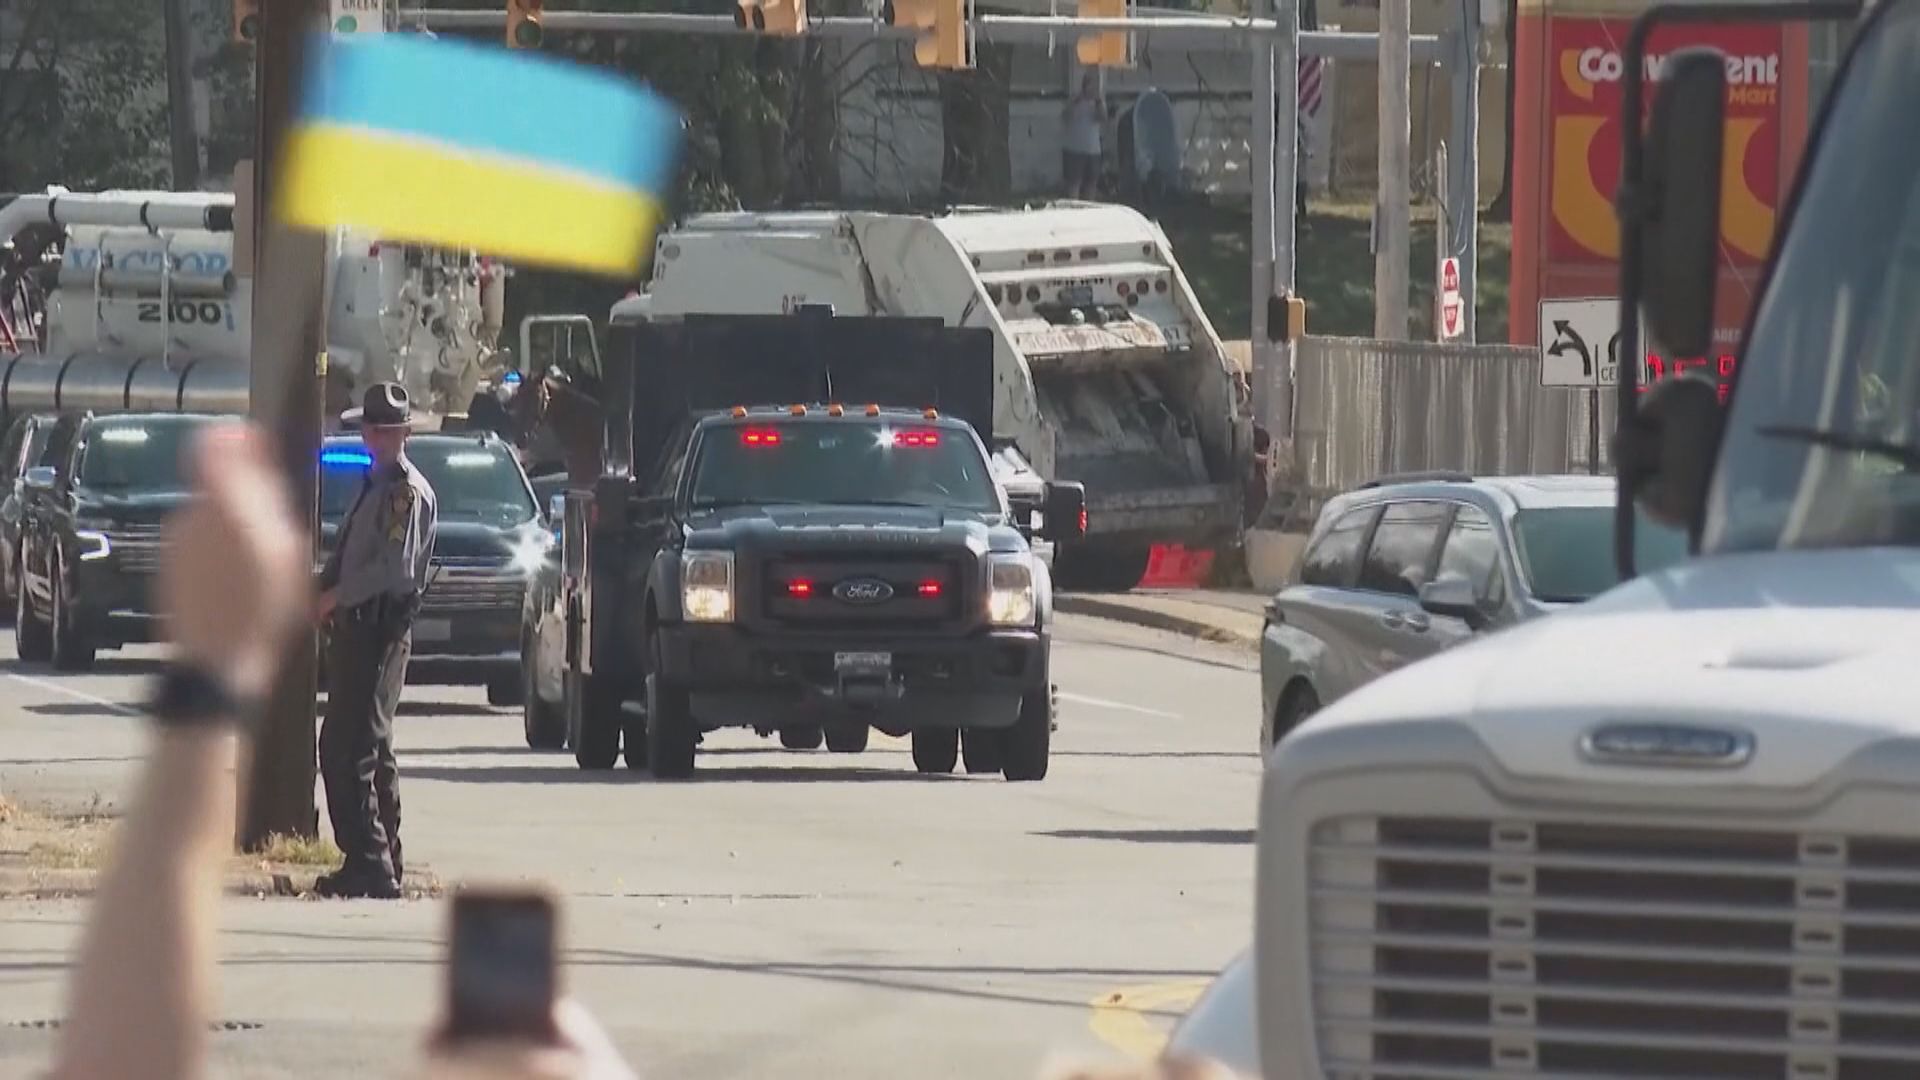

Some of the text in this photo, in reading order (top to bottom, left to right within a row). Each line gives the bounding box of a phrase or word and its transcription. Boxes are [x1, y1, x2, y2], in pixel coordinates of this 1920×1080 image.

[1579, 47, 1778, 84] Covent
[1729, 86, 1777, 105] Mart
[846, 583, 880, 599] Ford
